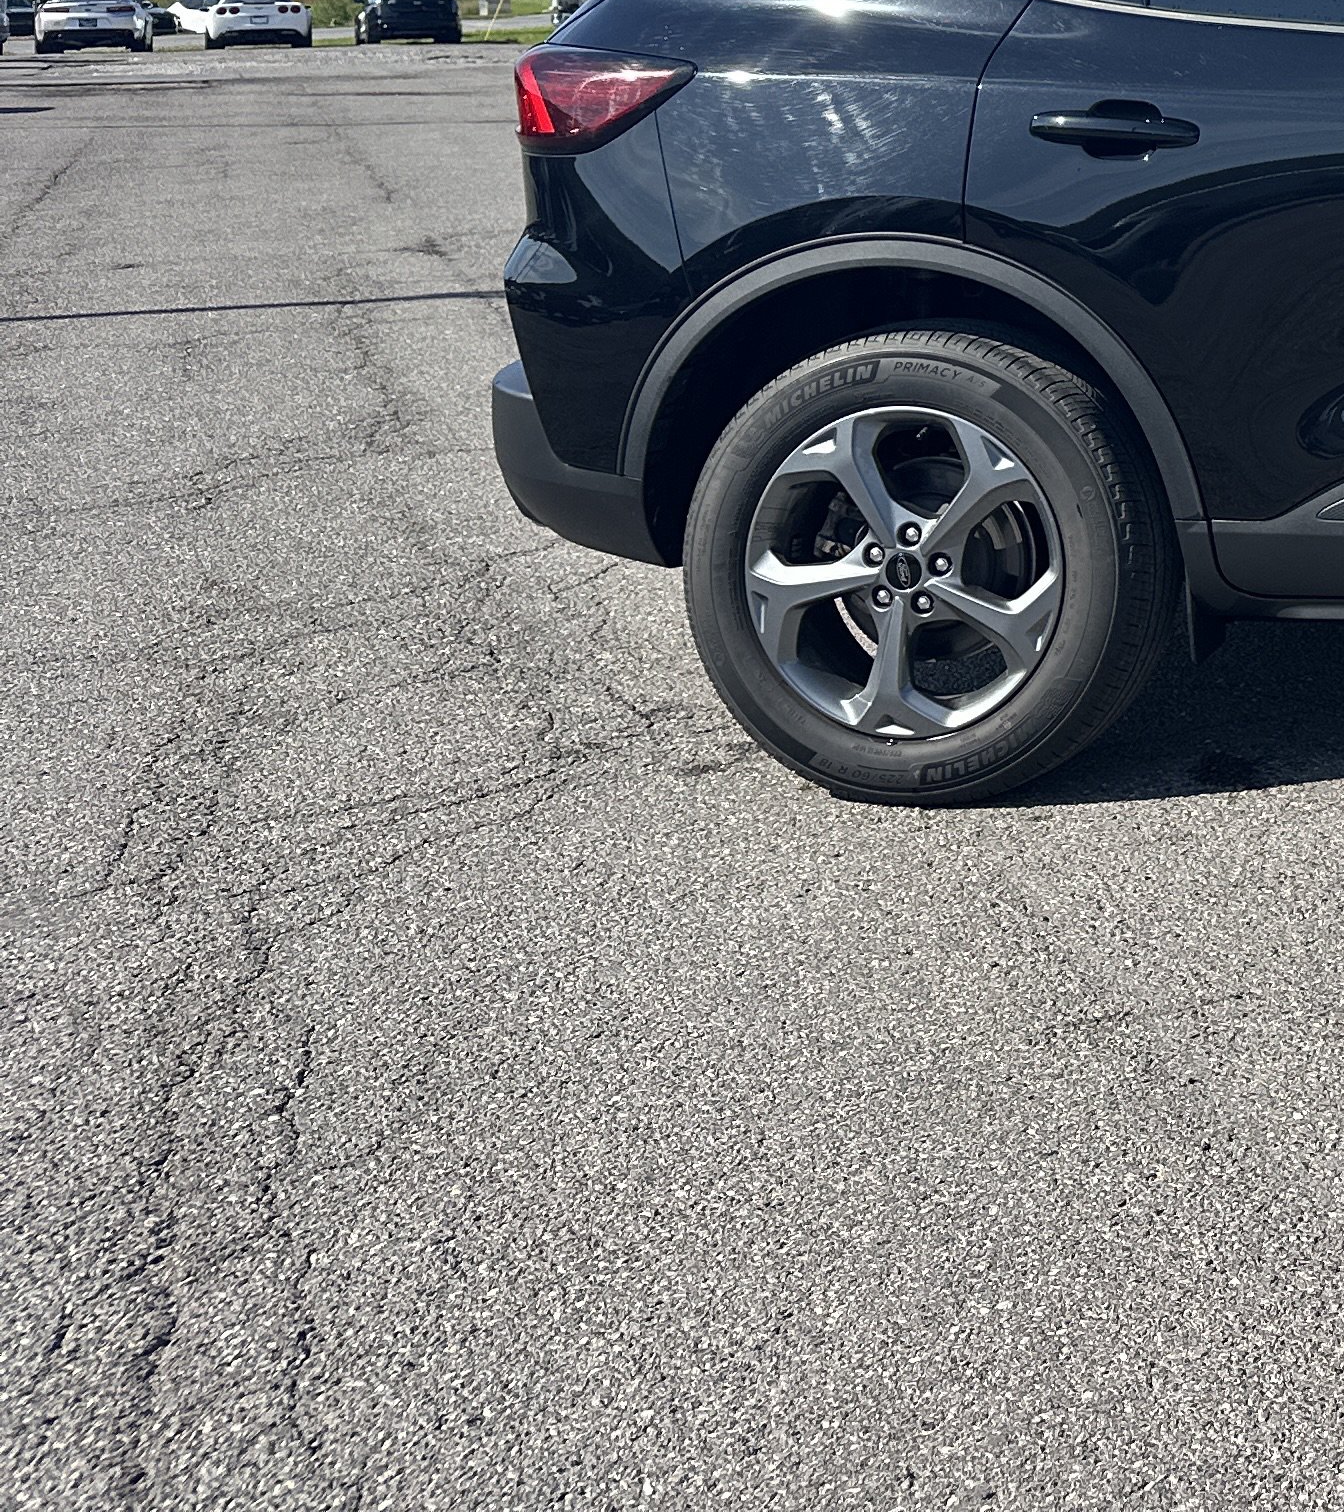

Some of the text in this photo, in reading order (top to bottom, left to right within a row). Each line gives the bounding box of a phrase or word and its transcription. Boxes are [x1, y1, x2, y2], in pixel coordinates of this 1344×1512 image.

[762, 360, 874, 432] MICHELIN
[893, 361, 961, 380] PRIMACY
[925, 716, 1038, 784] MICHELIN
